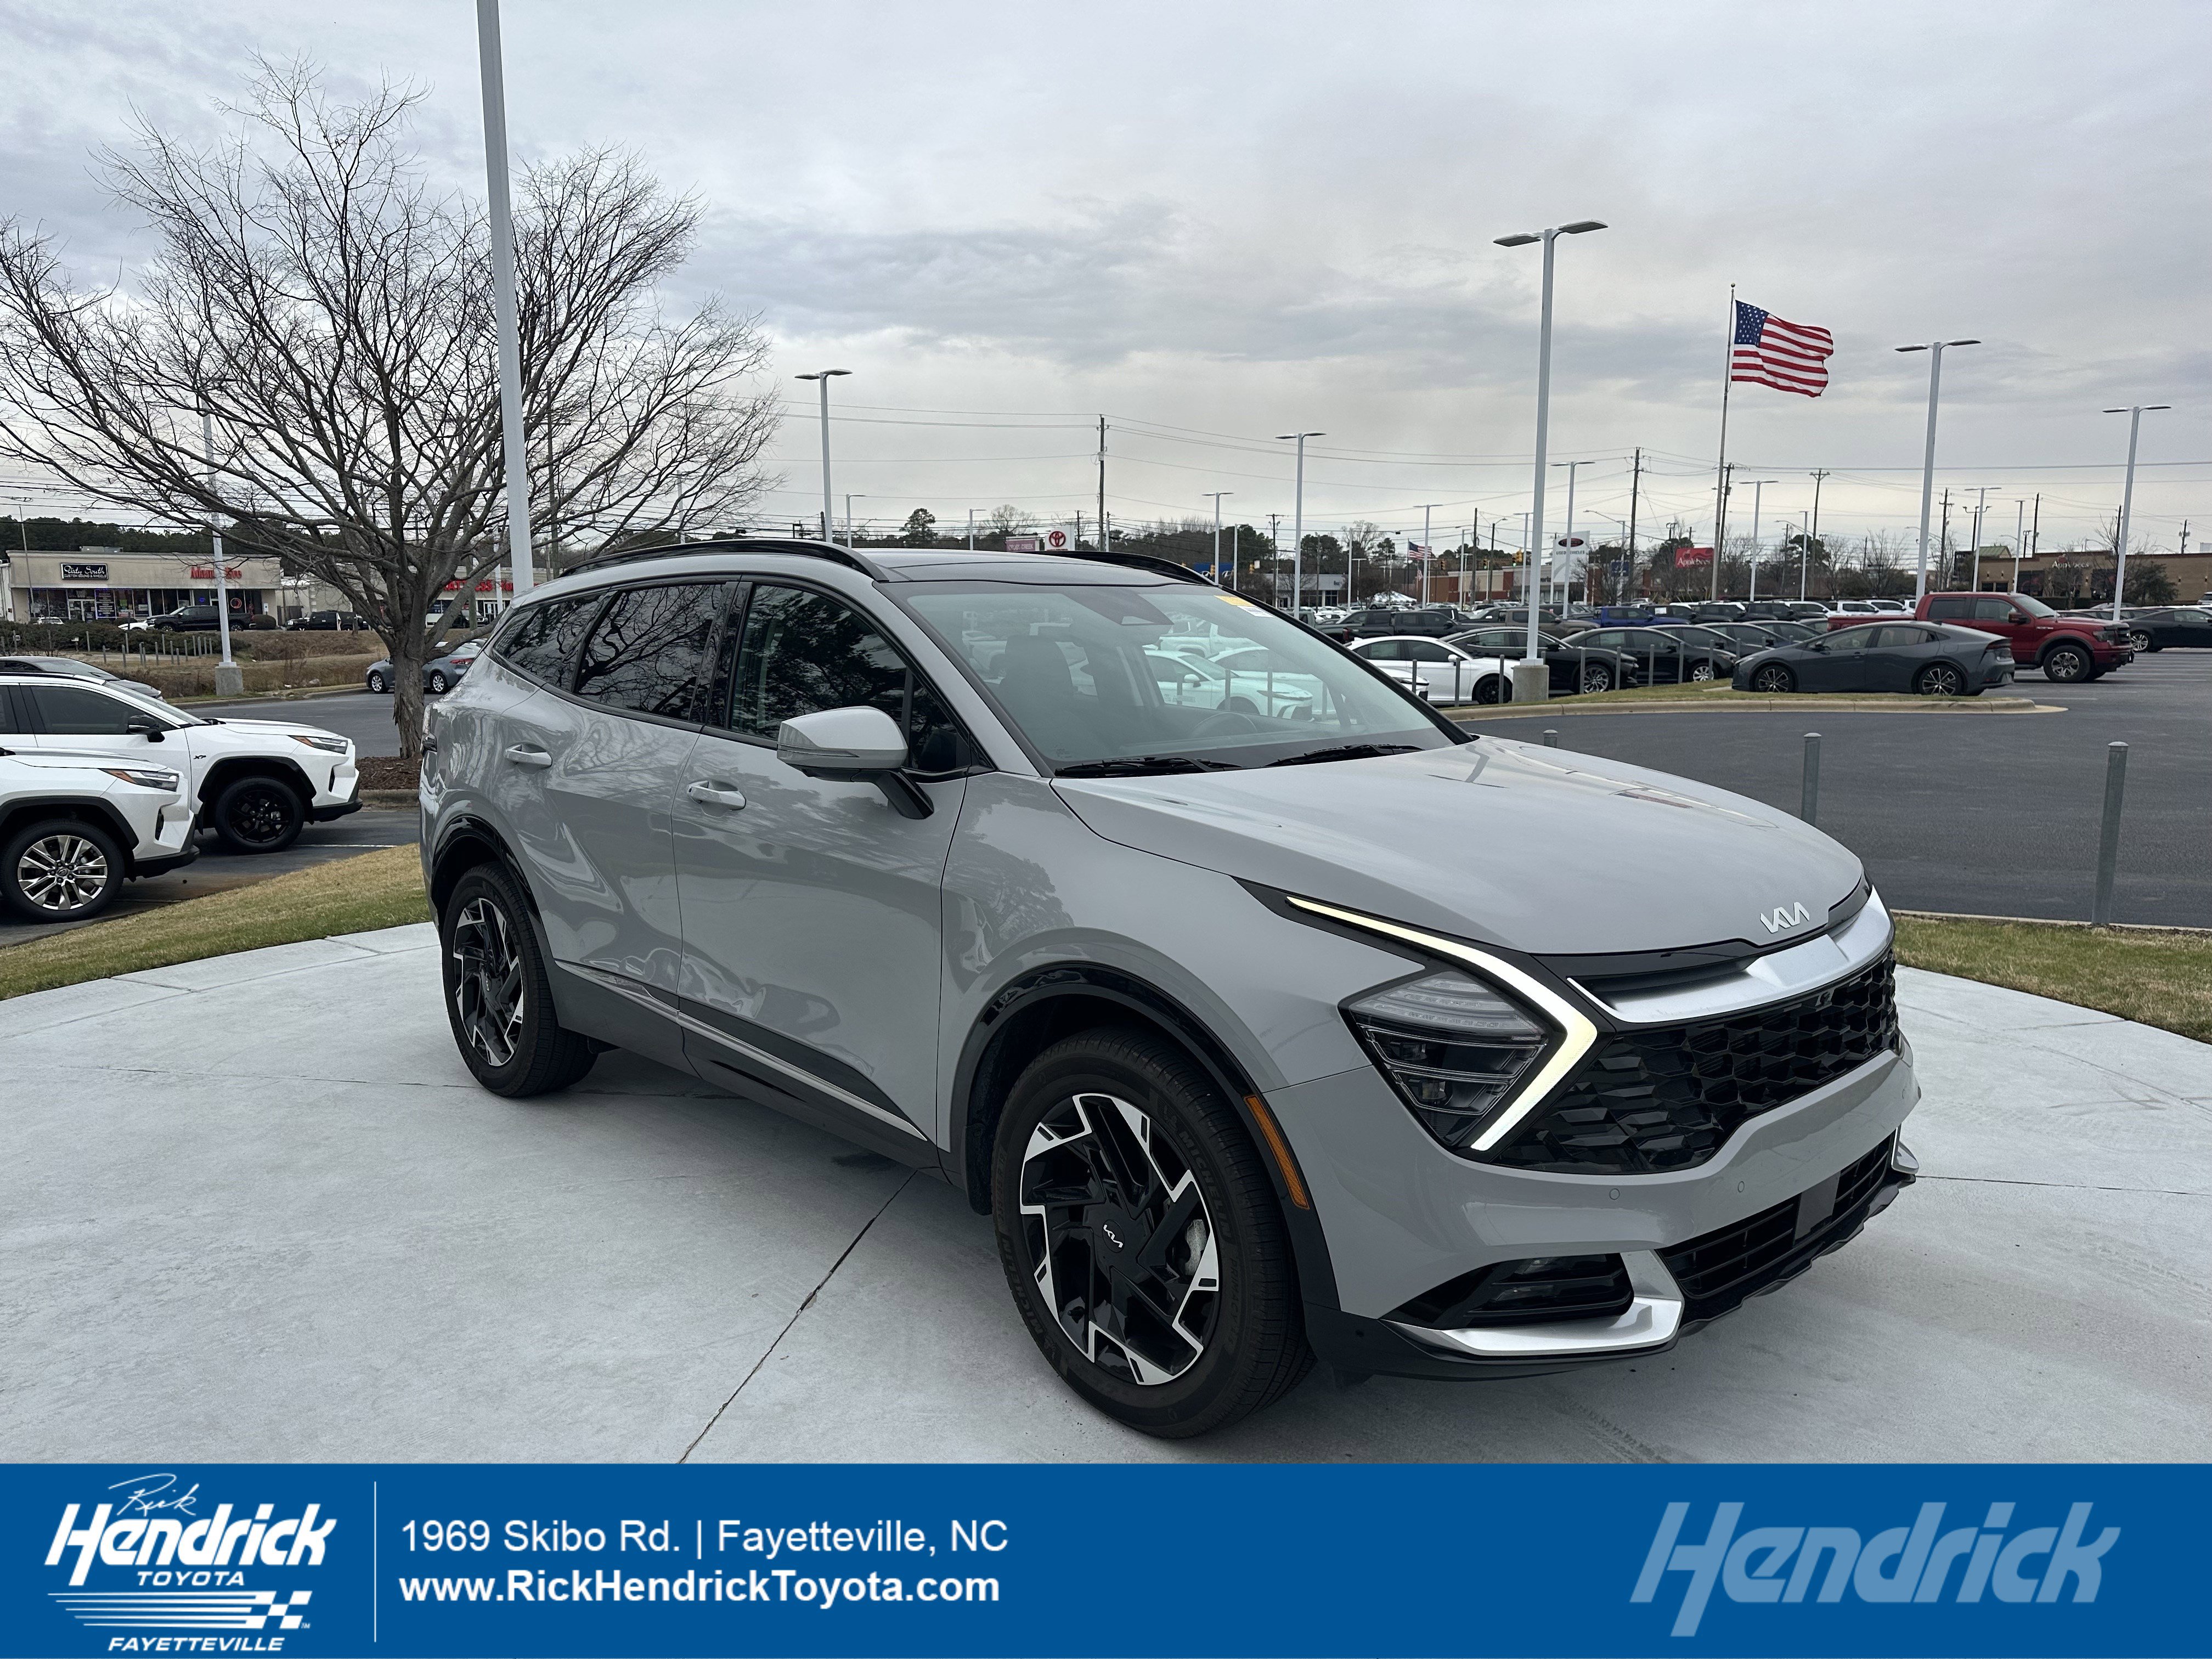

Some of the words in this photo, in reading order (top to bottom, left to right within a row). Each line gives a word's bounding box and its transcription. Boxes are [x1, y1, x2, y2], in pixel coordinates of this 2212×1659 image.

[64, 565, 82, 574] Dirty
[84, 566, 105, 574] South
[1760, 901, 1810, 933] KIA
[1179, 1130, 1232, 1238] MICHELIN
[1001, 1238, 1043, 1335] MICHELIN
